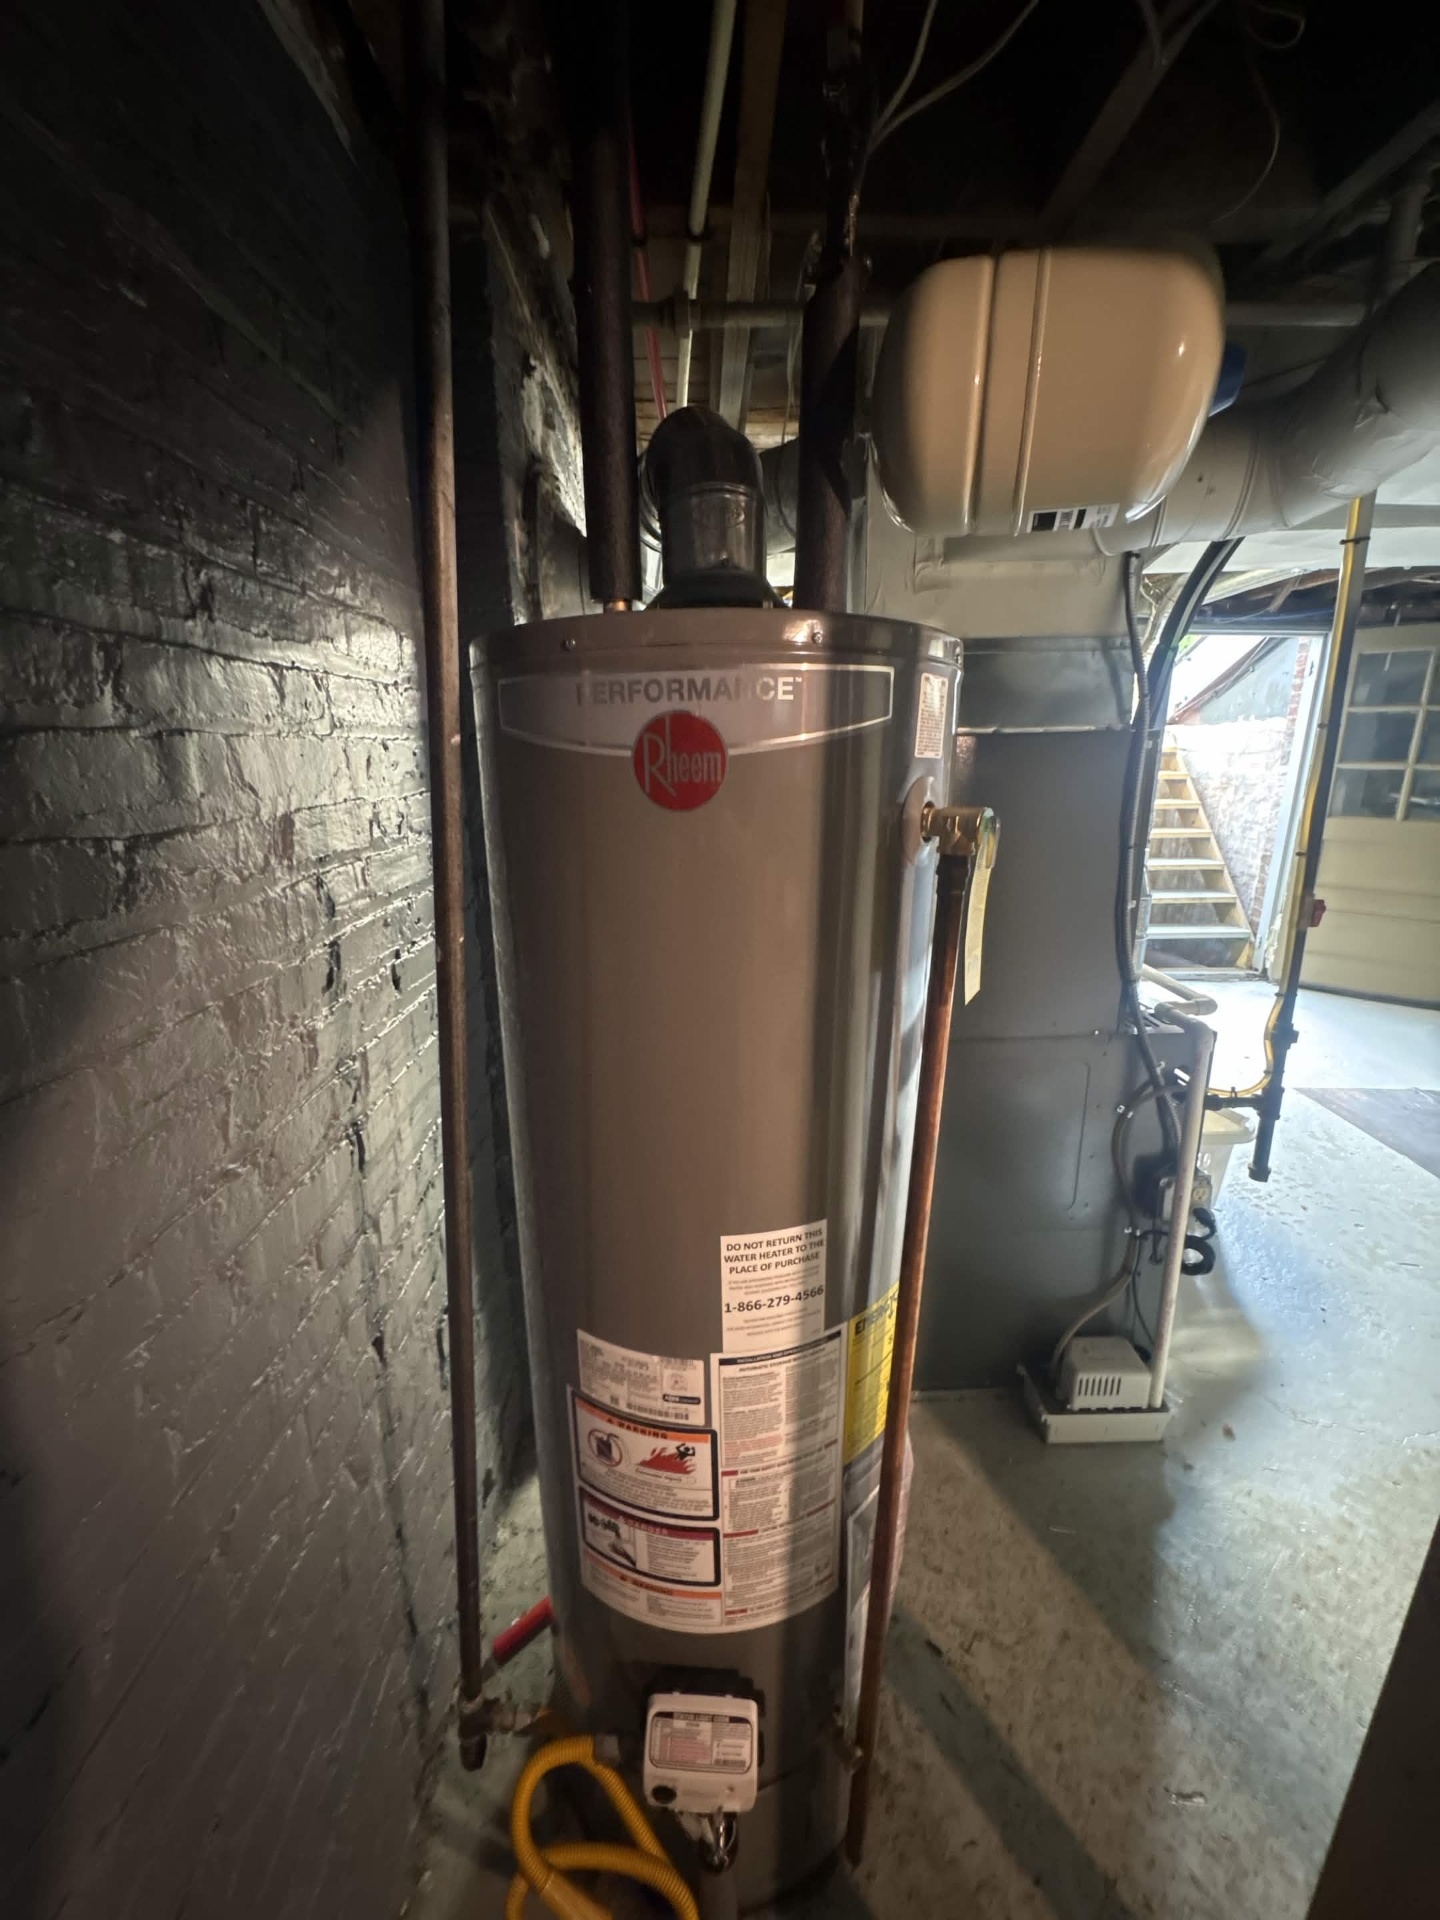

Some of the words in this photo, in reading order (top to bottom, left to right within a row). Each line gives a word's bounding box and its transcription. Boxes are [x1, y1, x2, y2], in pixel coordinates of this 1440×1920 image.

[643, 714, 723, 797] Rheem
[724, 1253, 757, 1263] WATER
[759, 1247, 793, 1260] HEATER
[795, 1244, 807, 1253] TO
[809, 1239, 824, 1249] THE
[726, 1243, 741, 1252] DO
[743, 1241, 764, 1250] NOT
[766, 1235, 802, 1247] RETURN
[804, 1227, 823, 1240] THIS
[729, 1264, 757, 1274] PLACE
[760, 1262, 773, 1271] OF
[775, 1252, 820, 1269] PURCHASE
[724, 1284, 824, 1313] 1-866-279-4566
[618, 1421, 668, 1439] WARNING
